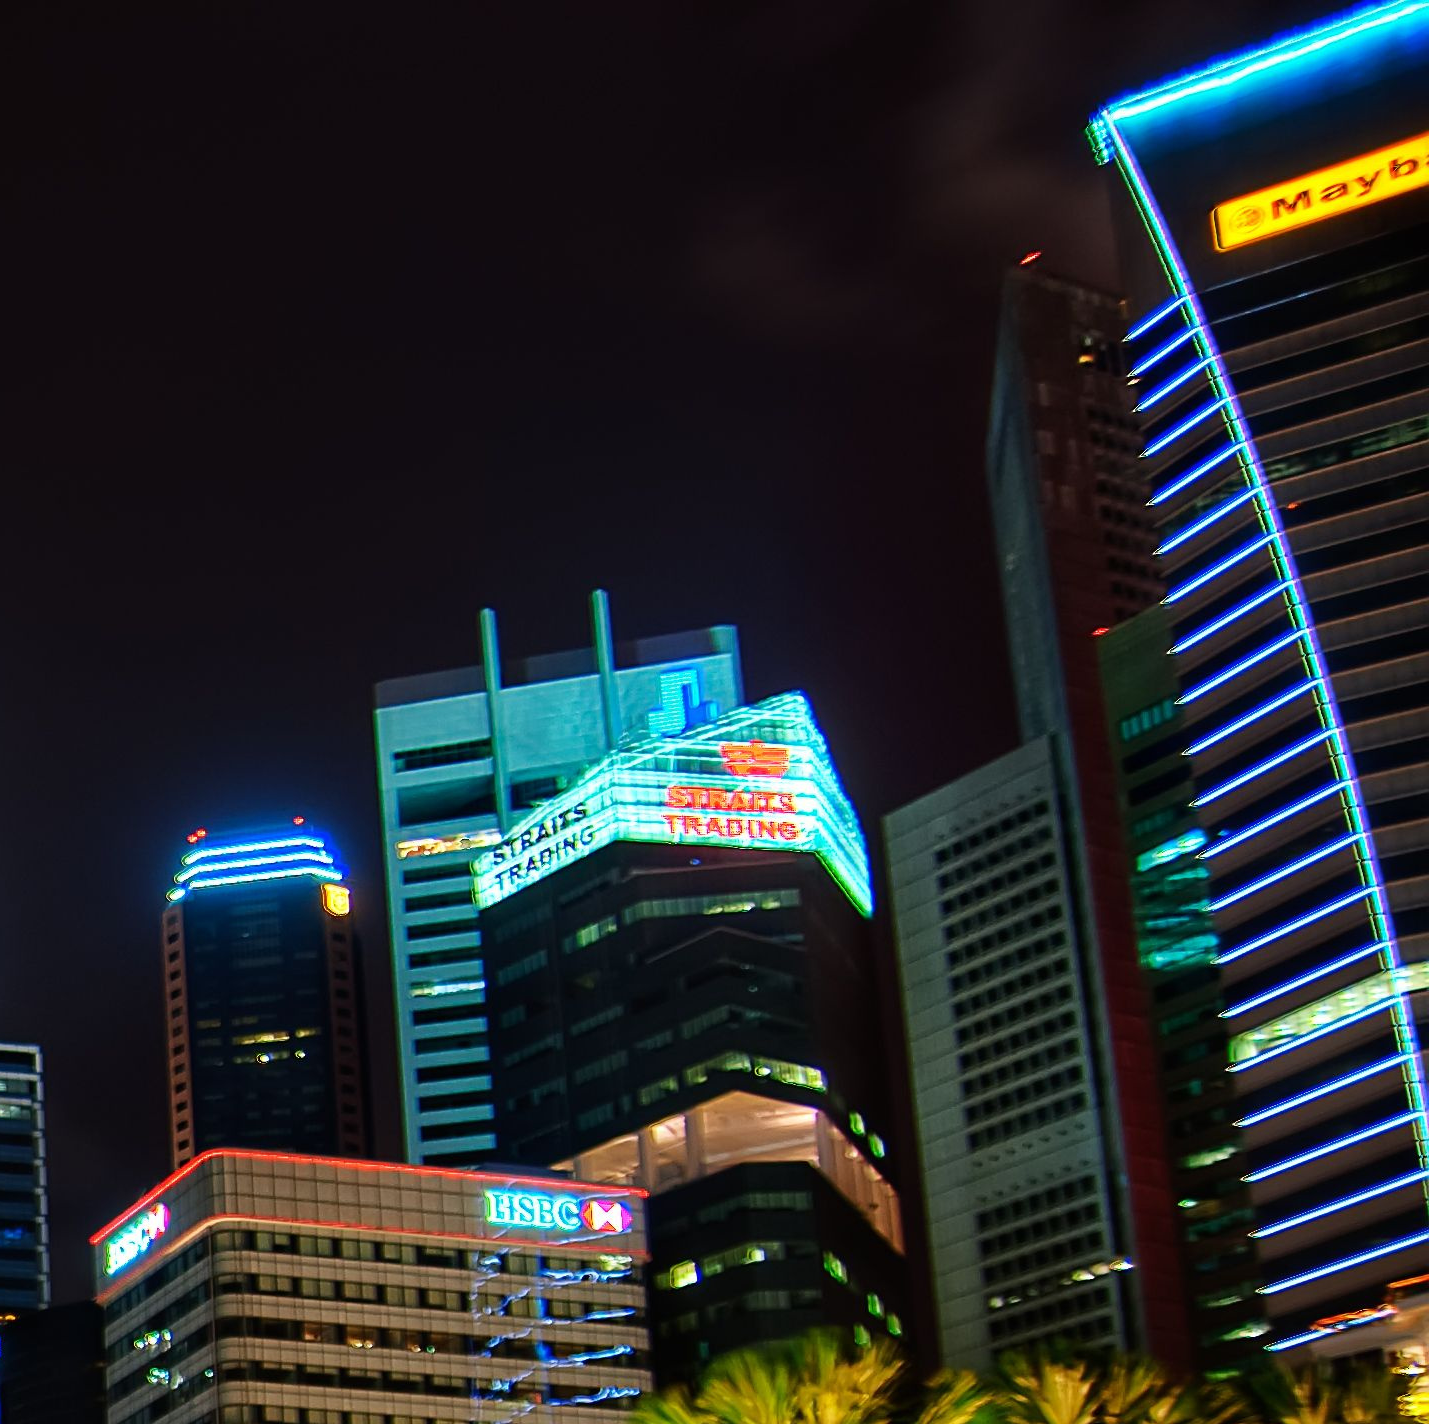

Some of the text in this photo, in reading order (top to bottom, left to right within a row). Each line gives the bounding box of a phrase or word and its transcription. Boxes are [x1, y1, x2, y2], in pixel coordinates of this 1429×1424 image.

[1271, 155, 1429, 220] Mayb
[665, 785, 797, 814] STRAITS
[493, 803, 589, 867] STRAITS
[663, 815, 799, 840] TRADING
[495, 826, 596, 891] TRADING
[483, 1189, 582, 1230] HSBC
